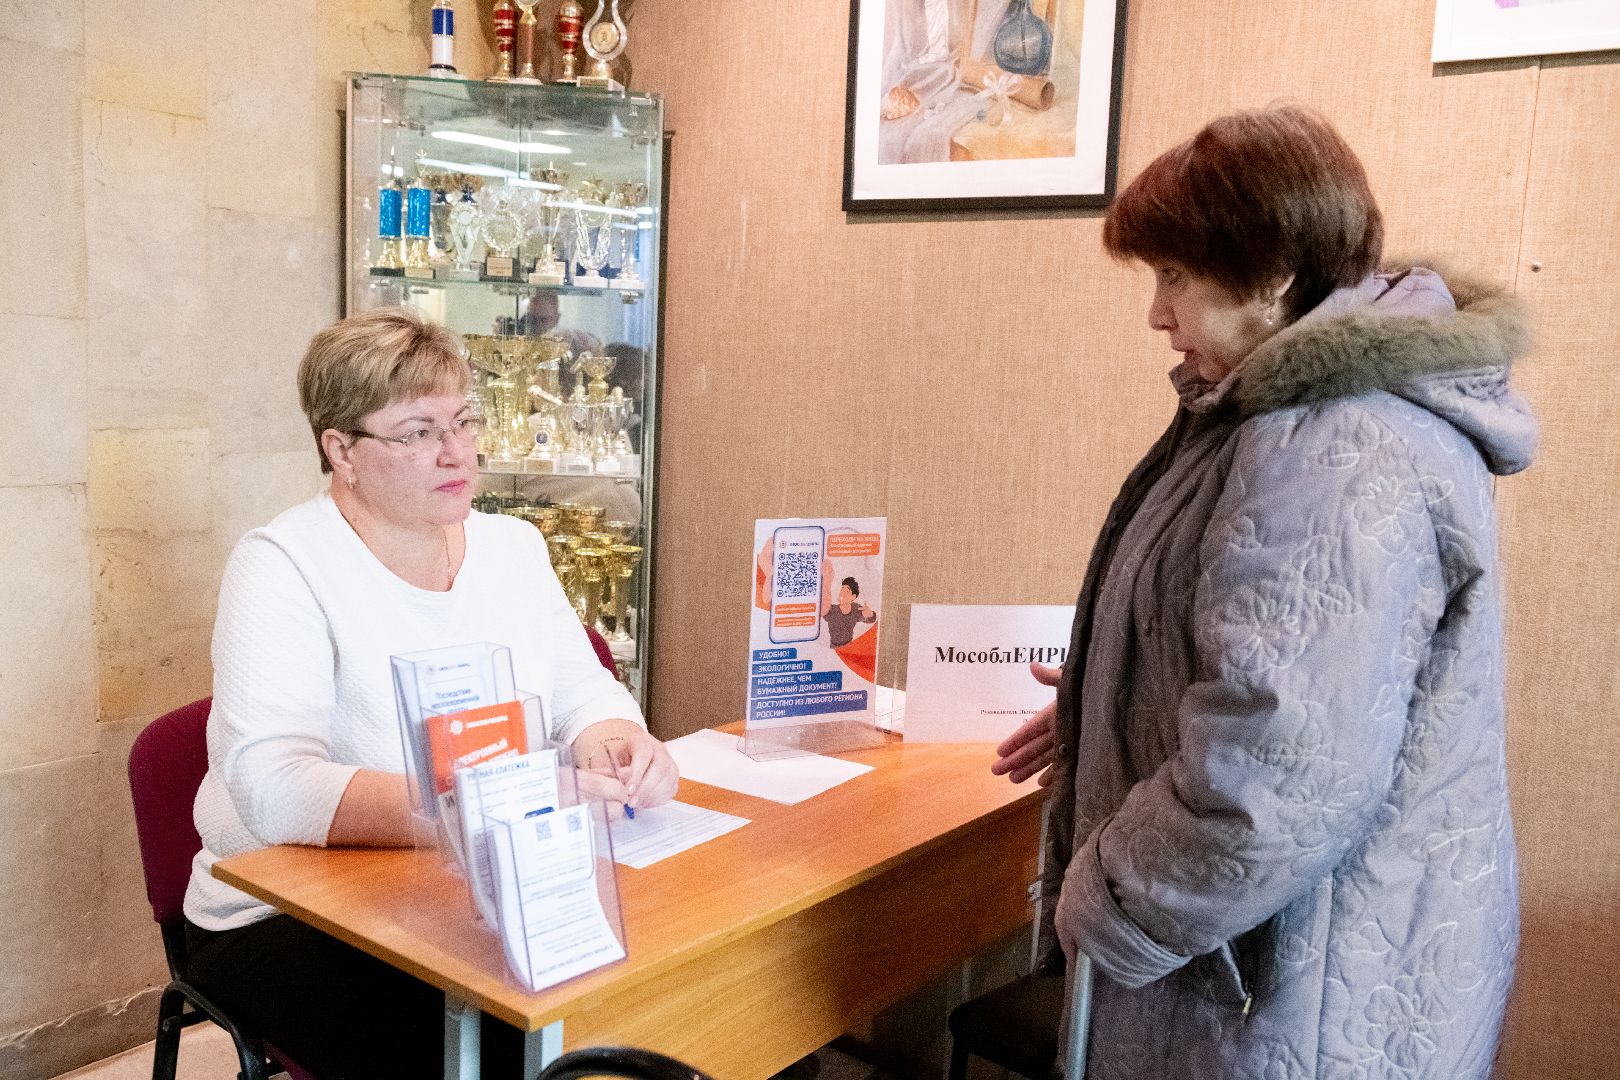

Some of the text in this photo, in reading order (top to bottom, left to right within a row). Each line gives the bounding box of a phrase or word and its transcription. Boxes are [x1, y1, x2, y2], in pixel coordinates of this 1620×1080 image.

[758, 650, 790, 660] УДОБНО!
[758, 663, 806, 673] ЭКОЛОГИЧНО!
[797, 674, 812, 683] ЧЕМ
[757, 682, 838, 695] БУМАЖНЫЙ ДОКУМЕНТ!
[756, 693, 864, 709] ДОСТУПНО ИЗ ЛЮБОГО РЕГИОНА
[756, 709, 786, 719] РОССИИ!
